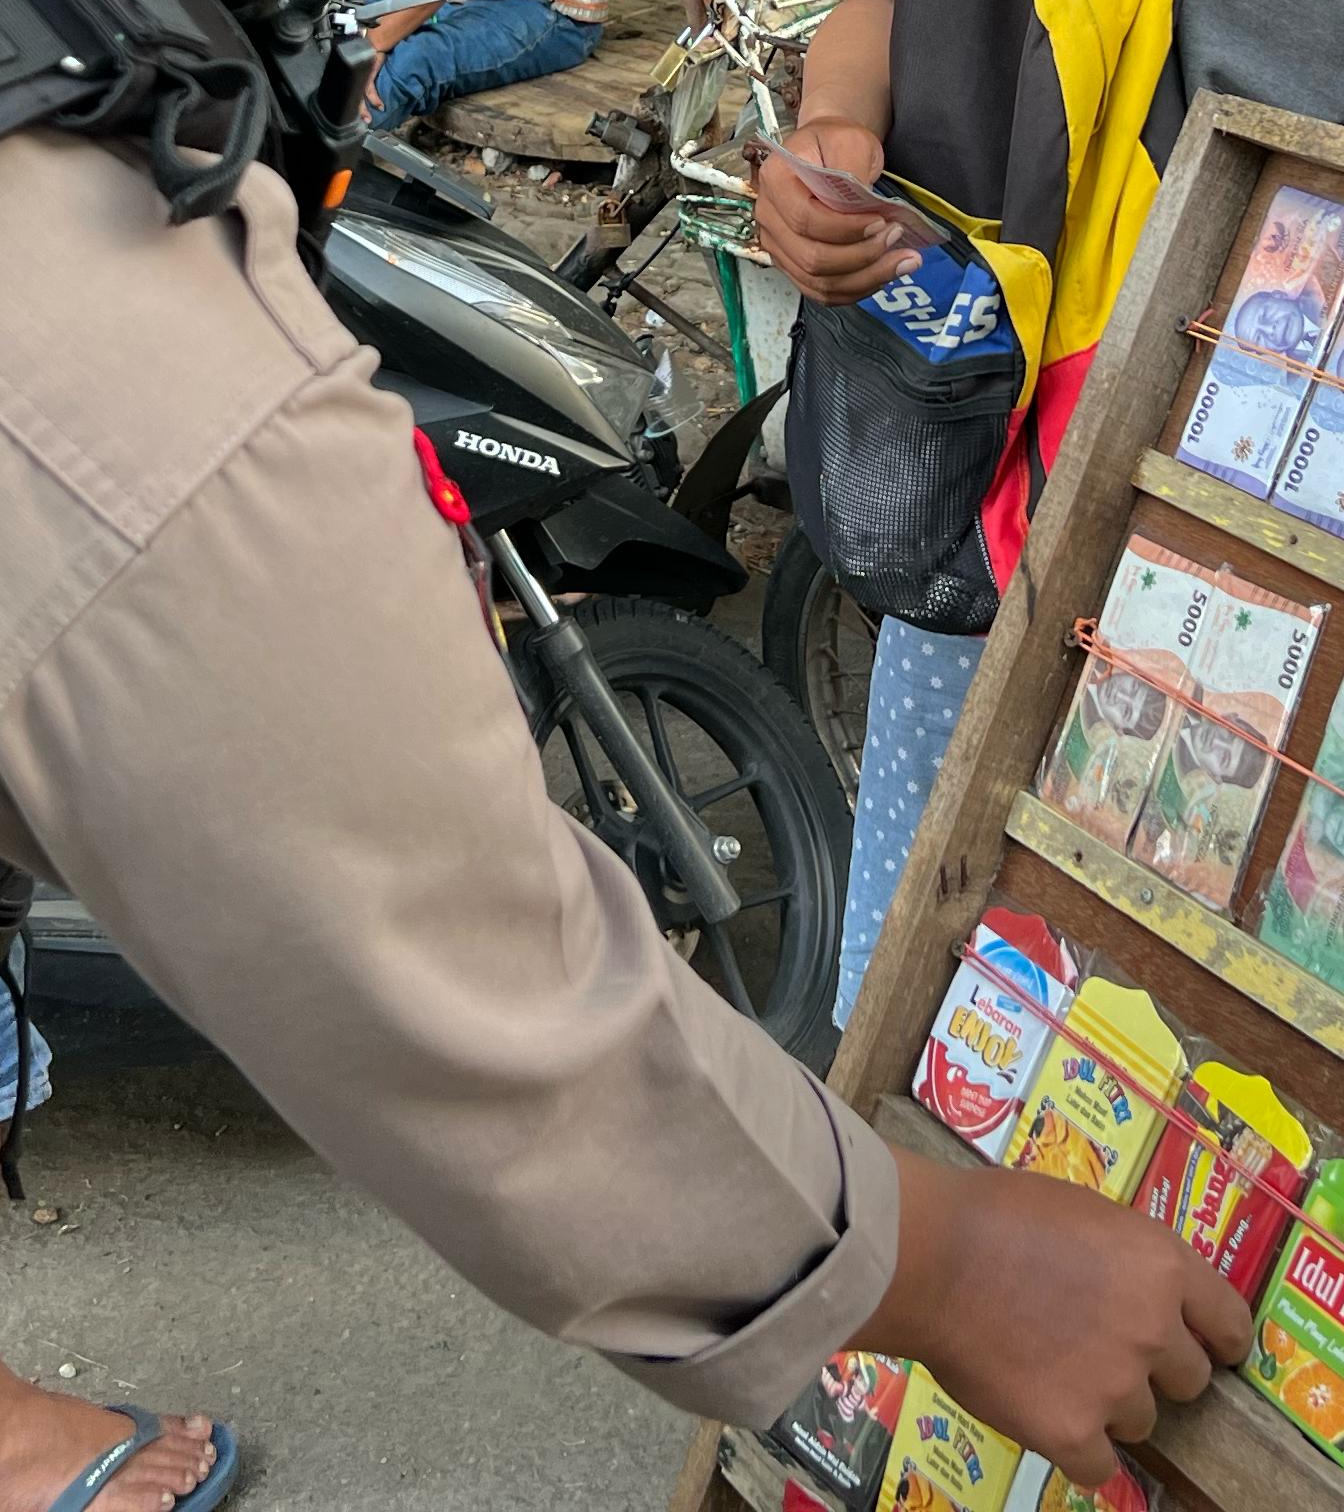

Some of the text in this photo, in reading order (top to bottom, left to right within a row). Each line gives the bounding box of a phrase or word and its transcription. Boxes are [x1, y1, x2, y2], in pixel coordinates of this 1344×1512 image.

[1184, 380, 1222, 445] 10000
[453, 429, 561, 476] HONDA
[1281, 425, 1323, 495] 10000
[1177, 590, 1208, 648] 5000
[1276, 629, 1310, 691] 5000
[947, 1005, 1024, 1076] ENJOY
[969, 984, 1026, 1040] Lebaran
[1063, 1057, 1096, 1083] IDUL
[1189, 1156, 1238, 1259] g-bang
[1216, 1250, 1233, 1277] THR
[917, 1418, 950, 1442] IDUL
